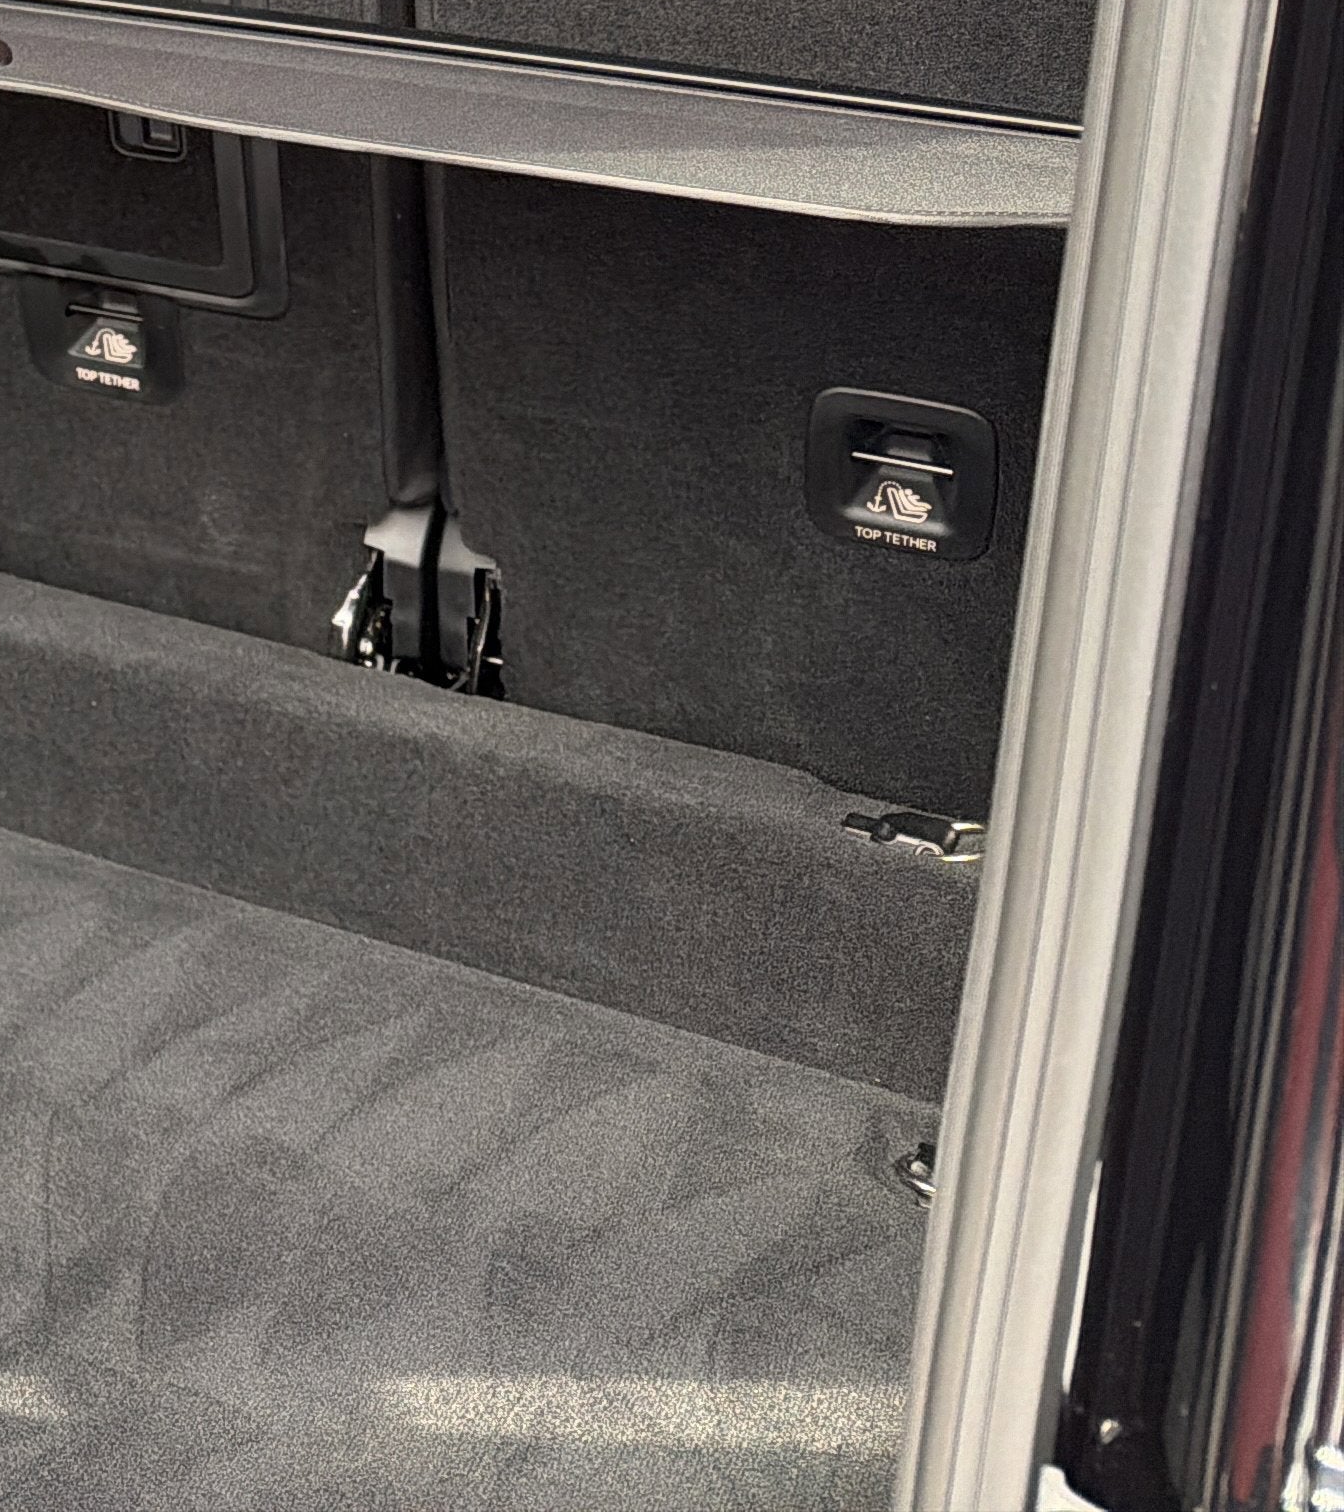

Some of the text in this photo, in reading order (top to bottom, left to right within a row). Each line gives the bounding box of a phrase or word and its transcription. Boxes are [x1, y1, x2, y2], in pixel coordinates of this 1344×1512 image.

[75, 366, 141, 392] TOP TETHER
[854, 525, 937, 553] TOP TETHER
